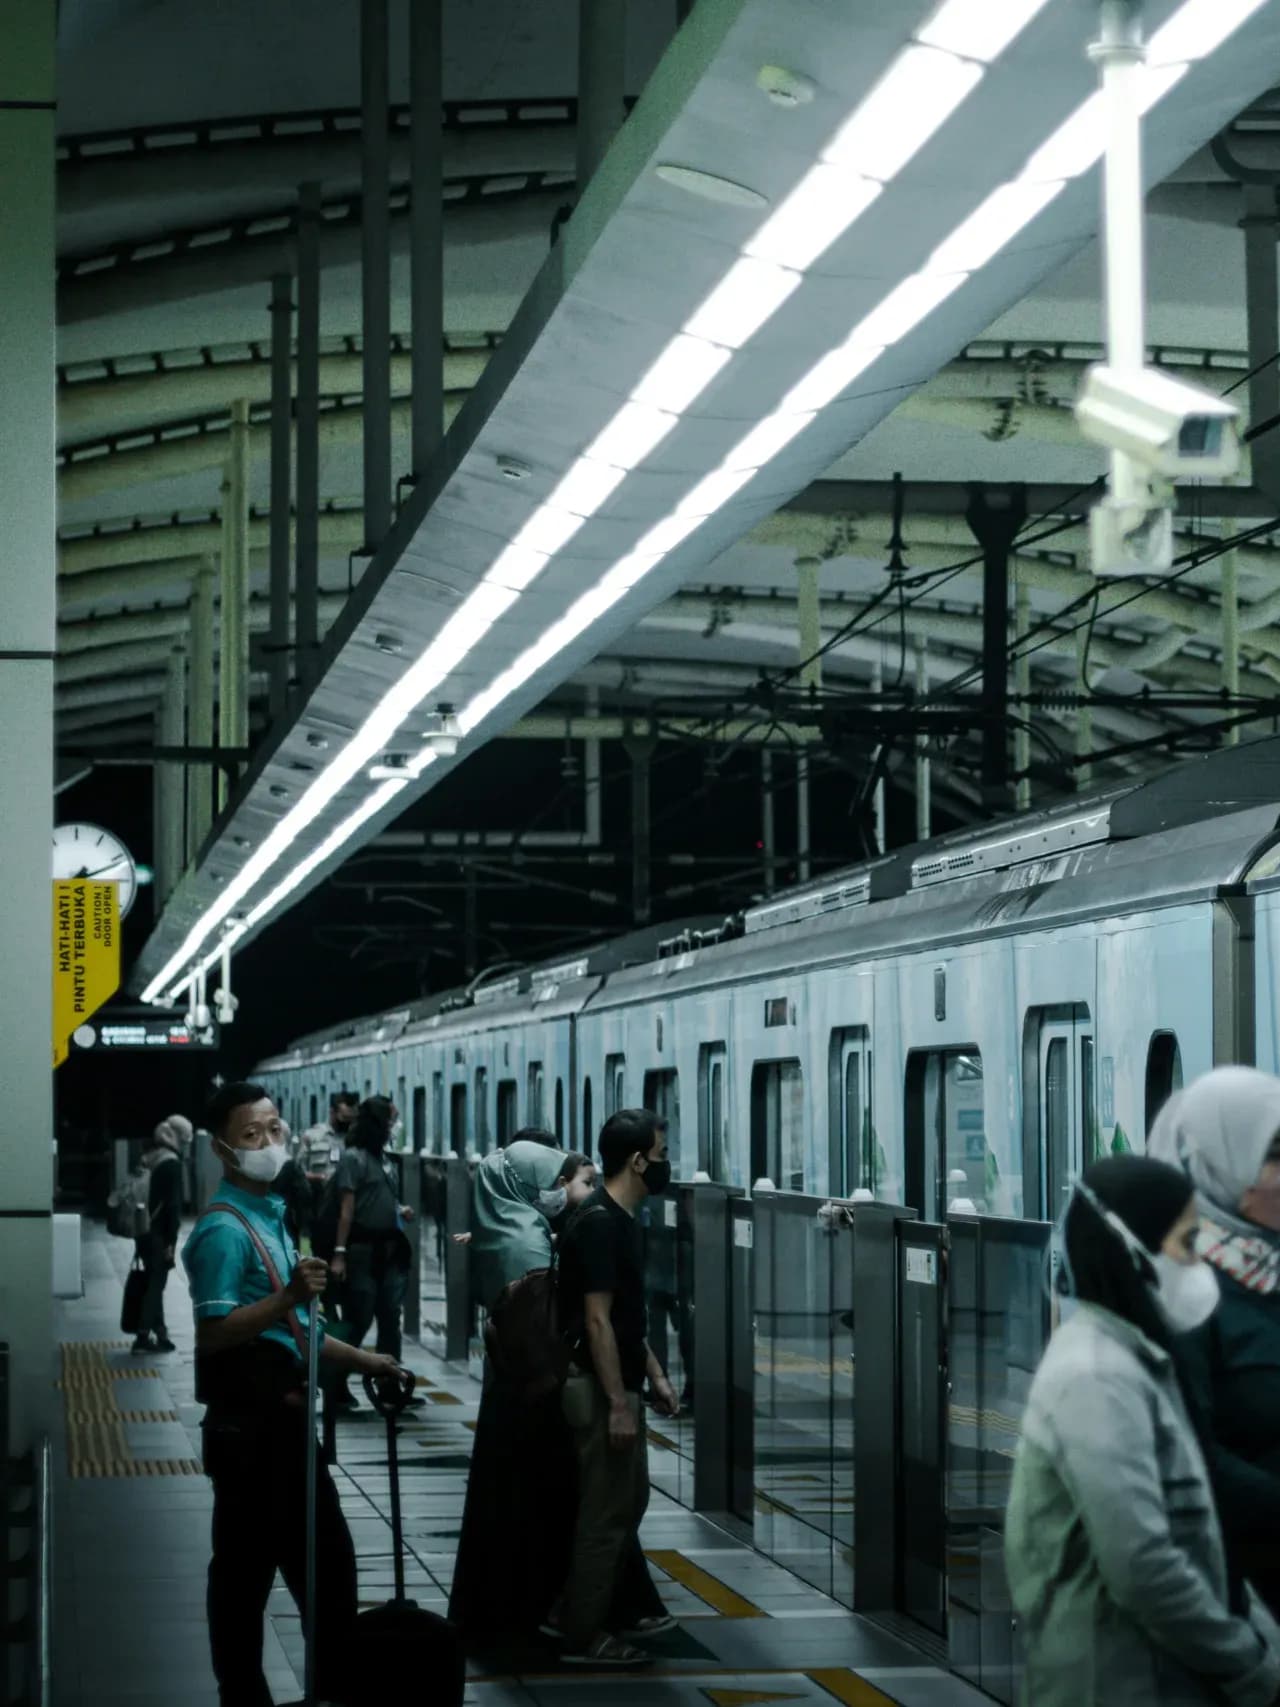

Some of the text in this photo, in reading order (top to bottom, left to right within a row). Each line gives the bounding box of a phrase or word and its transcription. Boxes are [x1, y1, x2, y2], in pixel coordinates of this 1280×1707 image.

[59, 895, 70, 972] HATI-HATI
[74, 885, 85, 1013] PINTU TERBUKA
[93, 892, 102, 939] CAUTION
[103, 885, 112, 947] DOOR OPEN
